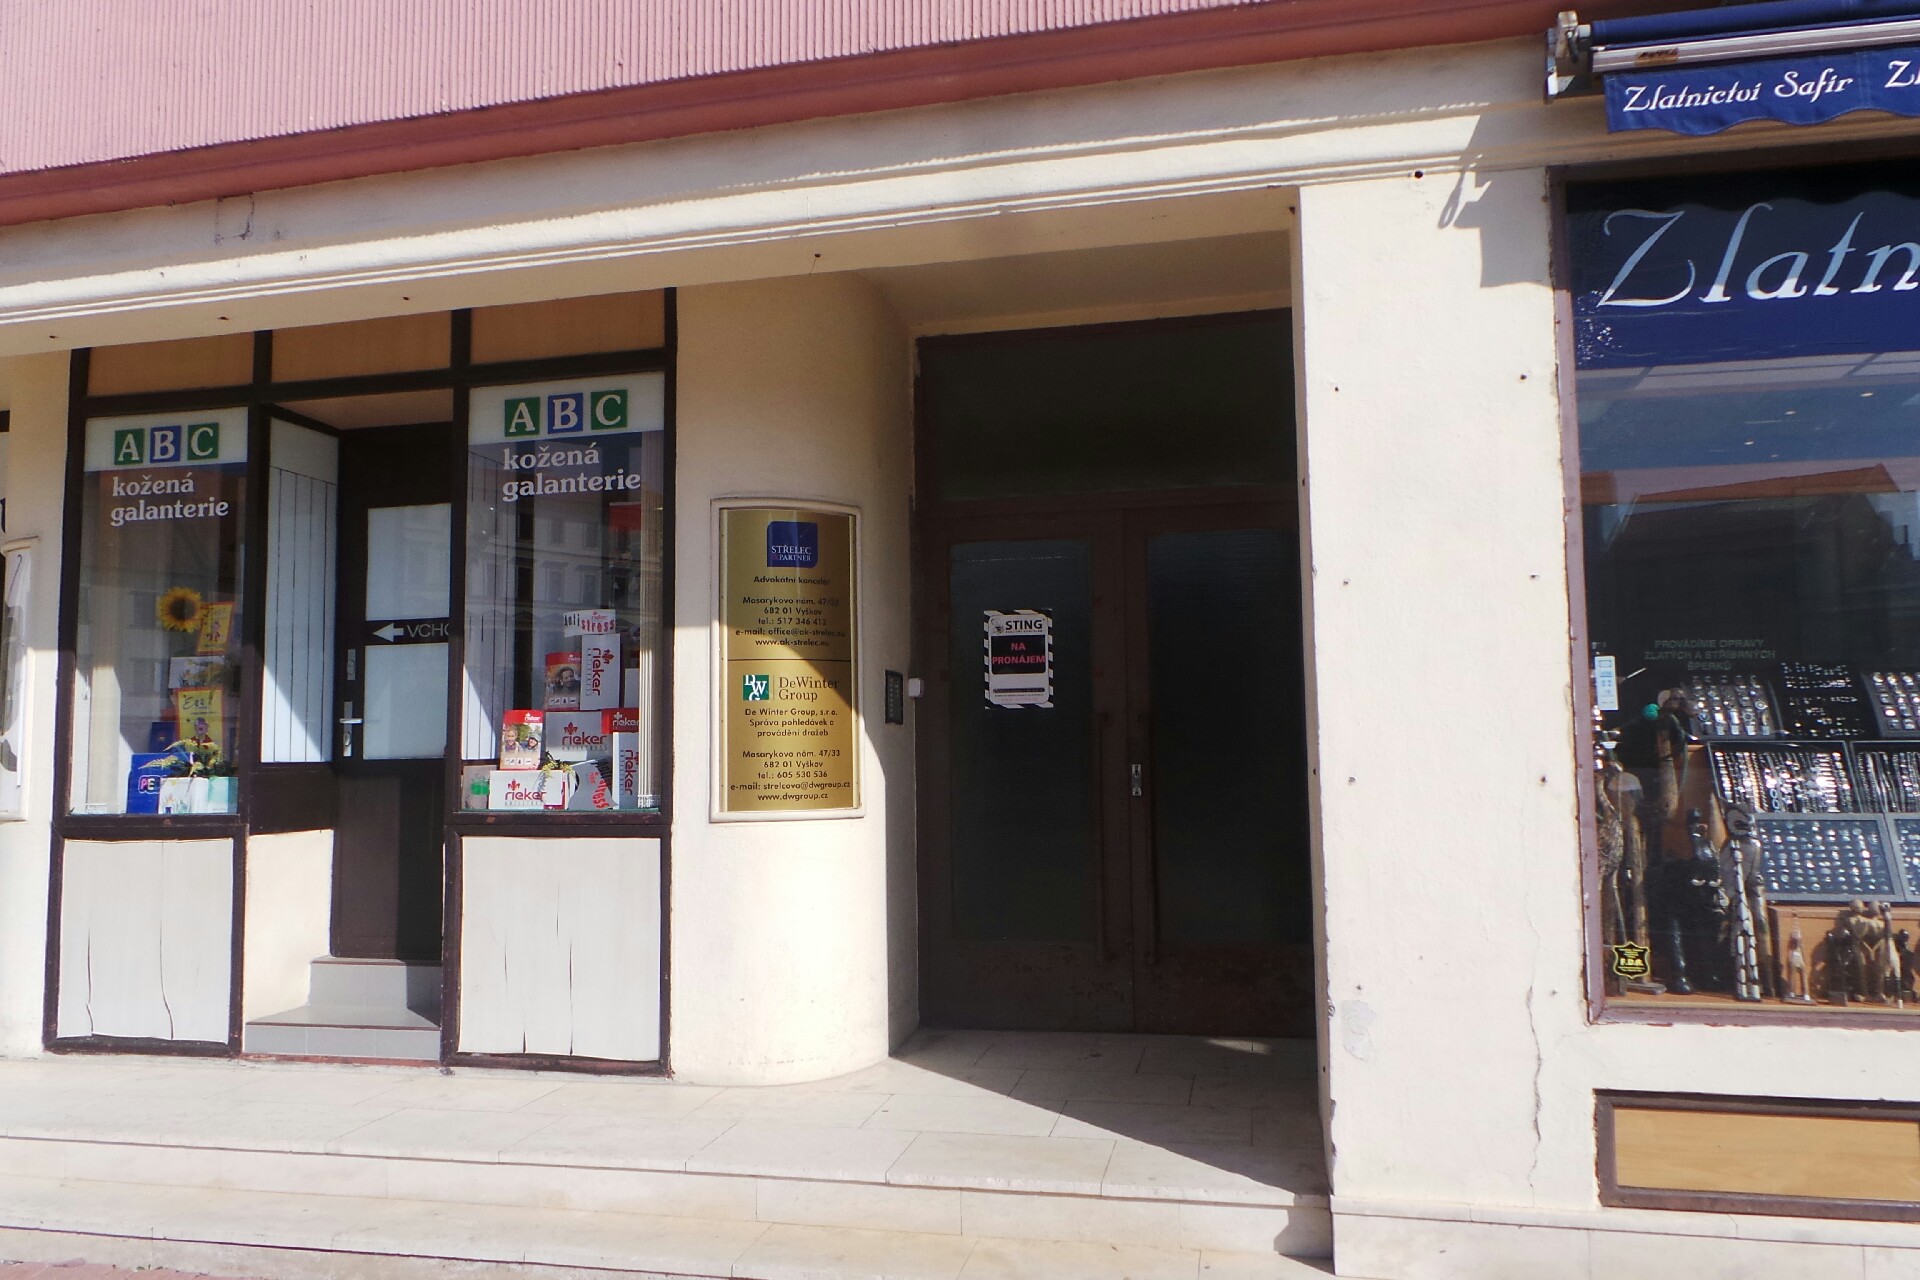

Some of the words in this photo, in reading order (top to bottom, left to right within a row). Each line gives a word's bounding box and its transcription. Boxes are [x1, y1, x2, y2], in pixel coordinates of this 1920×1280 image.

[508, 393, 622, 433] ABC
[117, 427, 214, 462] ABC
[503, 441, 600, 470] kožená
[112, 472, 195, 497] kožená
[502, 468, 641, 502] galanterie
[110, 497, 229, 527] galanterie
[796, 607, 822, 616] Vyškov
[796, 618, 811, 626] 346
[1005, 620, 1043, 630] STING
[735, 627, 765, 636] e-mail:
[1011, 642, 1026, 651] NA
[992, 655, 1046, 664] PRONÁJEM
[592, 648, 604, 696] rieker
[778, 676, 840, 689] DeWinter
[778, 688, 818, 702] Group
[745, 708, 757, 716] De
[759, 708, 788, 716] Winter
[790, 708, 818, 717] Group,
[781, 718, 828, 727] pohledávek
[802, 728, 829, 736] dražeb
[562, 731, 608, 745] rieker
[818, 749, 840, 757] 47/33
[795, 760, 824, 769] Vyškov
[624, 750, 637, 796] rieker
[813, 770, 828, 778] 536
[730, 782, 761, 791] e-mail:
[505, 788, 548, 801] rieker
[757, 792, 829, 801] www.dwgroup.cz
